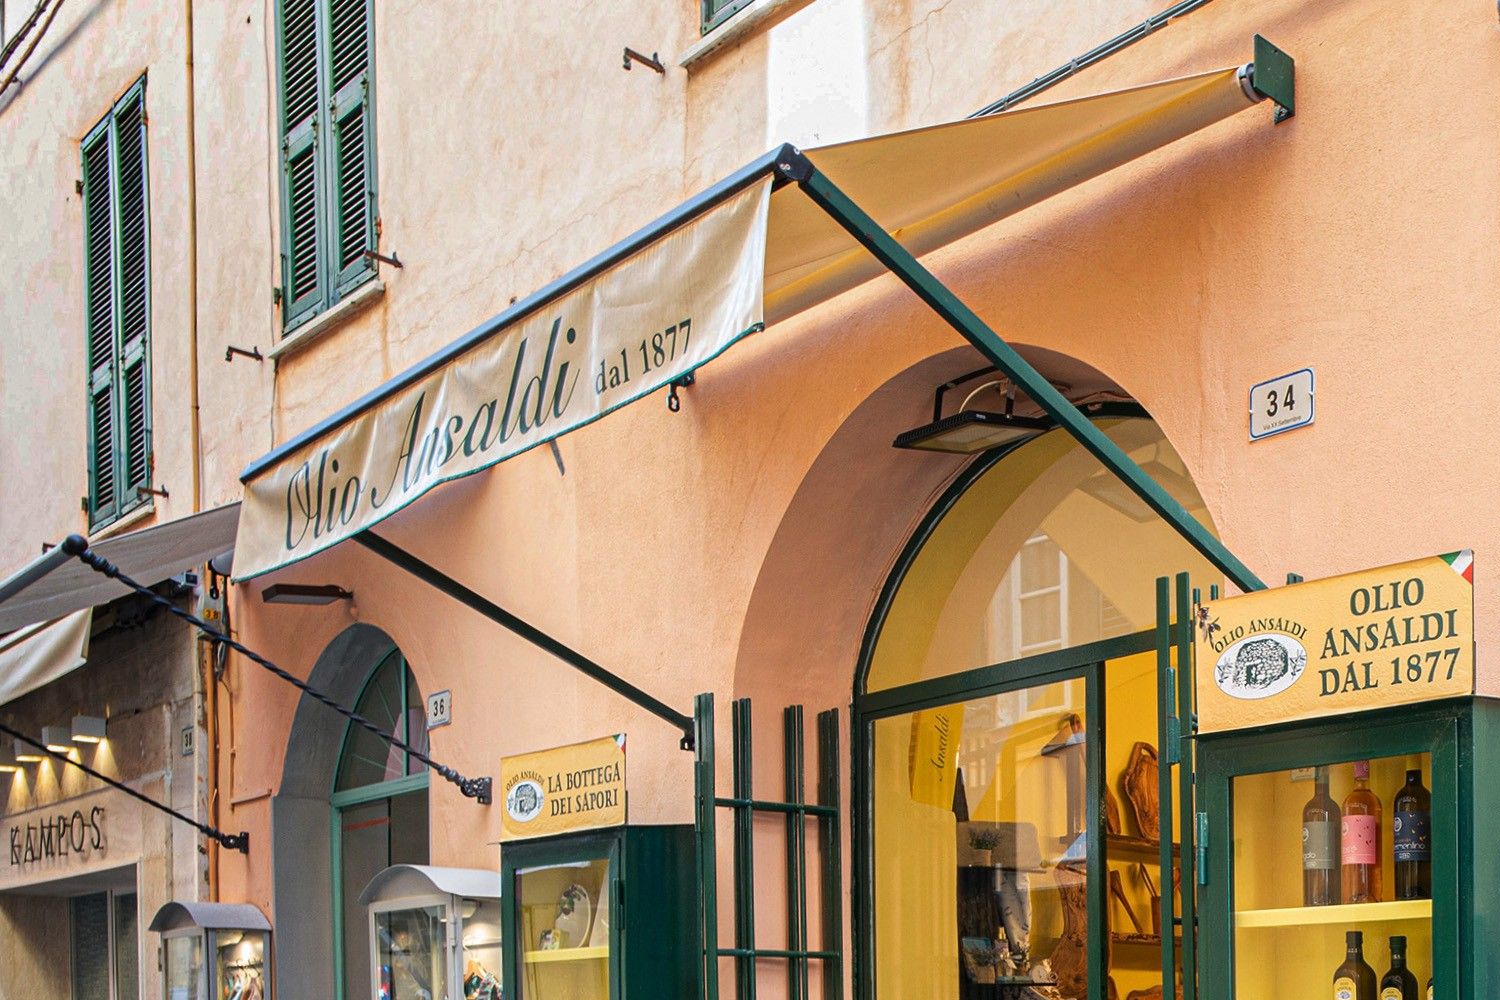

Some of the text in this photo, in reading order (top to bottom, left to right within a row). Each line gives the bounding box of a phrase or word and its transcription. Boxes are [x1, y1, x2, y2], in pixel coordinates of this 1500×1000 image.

[1266, 384, 1295, 417] 34
[285, 316, 692, 551] Olio Ansaldi dal 1877
[1350, 577, 1424, 617] OLIO
[1214, 617, 1308, 654] OLIO ANSALDI
[1319, 609, 1458, 660] ANSALDI
[1318, 647, 1461, 697] DAL 1877
[433, 698, 445, 717] 36
[547, 761, 621, 794] LA BOTTEGA
[551, 789, 618, 817] DEI SAPORI
[10, 806, 102, 866] KAMPOS
